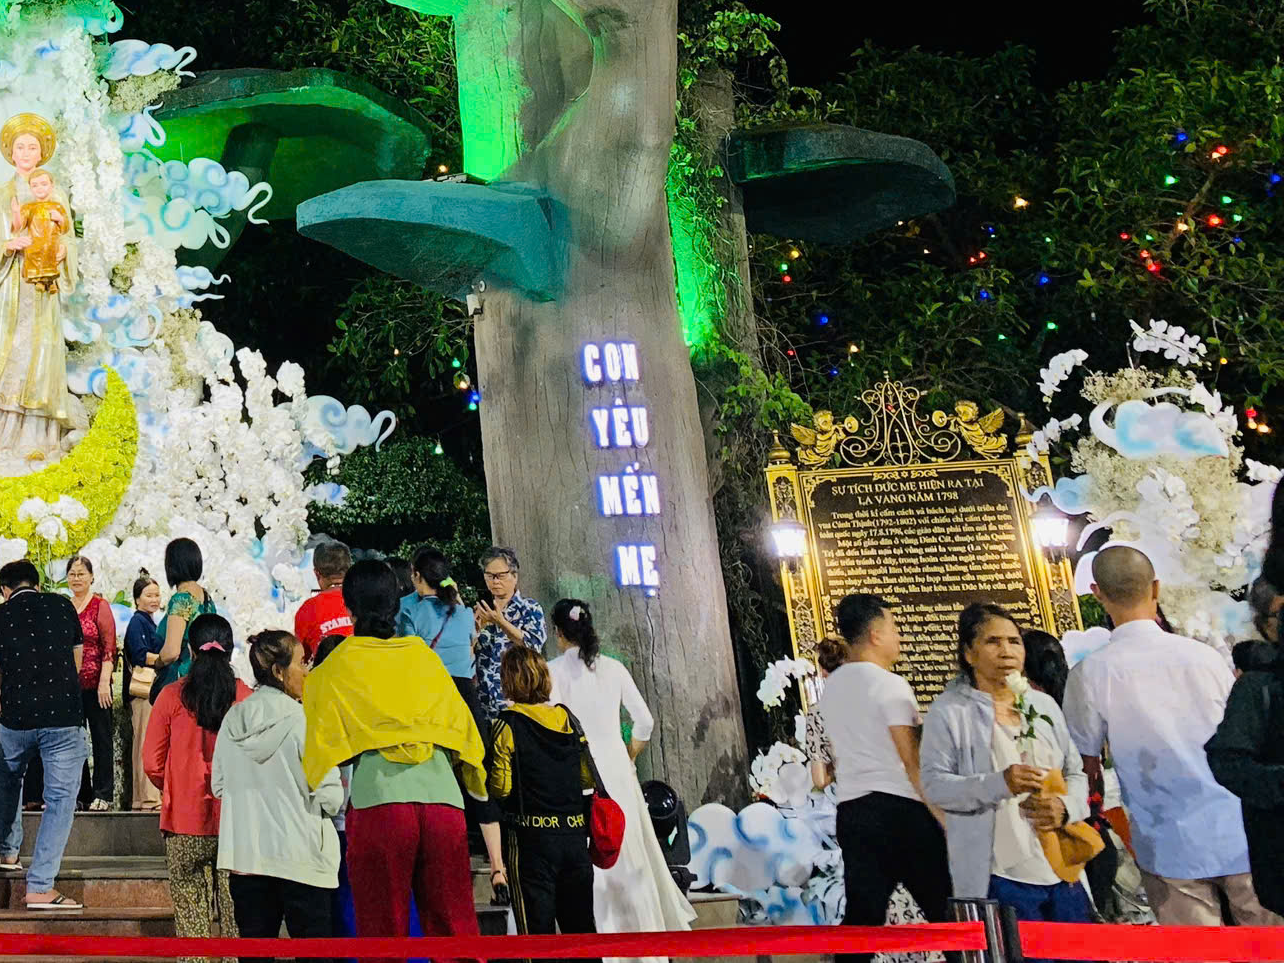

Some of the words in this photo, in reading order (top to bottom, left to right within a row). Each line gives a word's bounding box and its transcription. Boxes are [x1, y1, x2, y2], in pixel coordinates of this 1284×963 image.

[583, 342, 640, 383] CON
[591, 397, 651, 449] YÊU
[598, 461, 661, 515] MẾN
[847, 482, 873, 494] TÍCH
[899, 481, 917, 492] MẸ
[918, 479, 945, 490] HIỆN
[947, 479, 963, 488] RA
[964, 478, 984, 489] TẠI
[874, 494, 907, 504] VANG
[907, 491, 934, 502] NĂM
[936, 491, 959, 501] 1798
[616, 544, 660, 598] MẸ
[532, 816, 560, 828] DIOR
